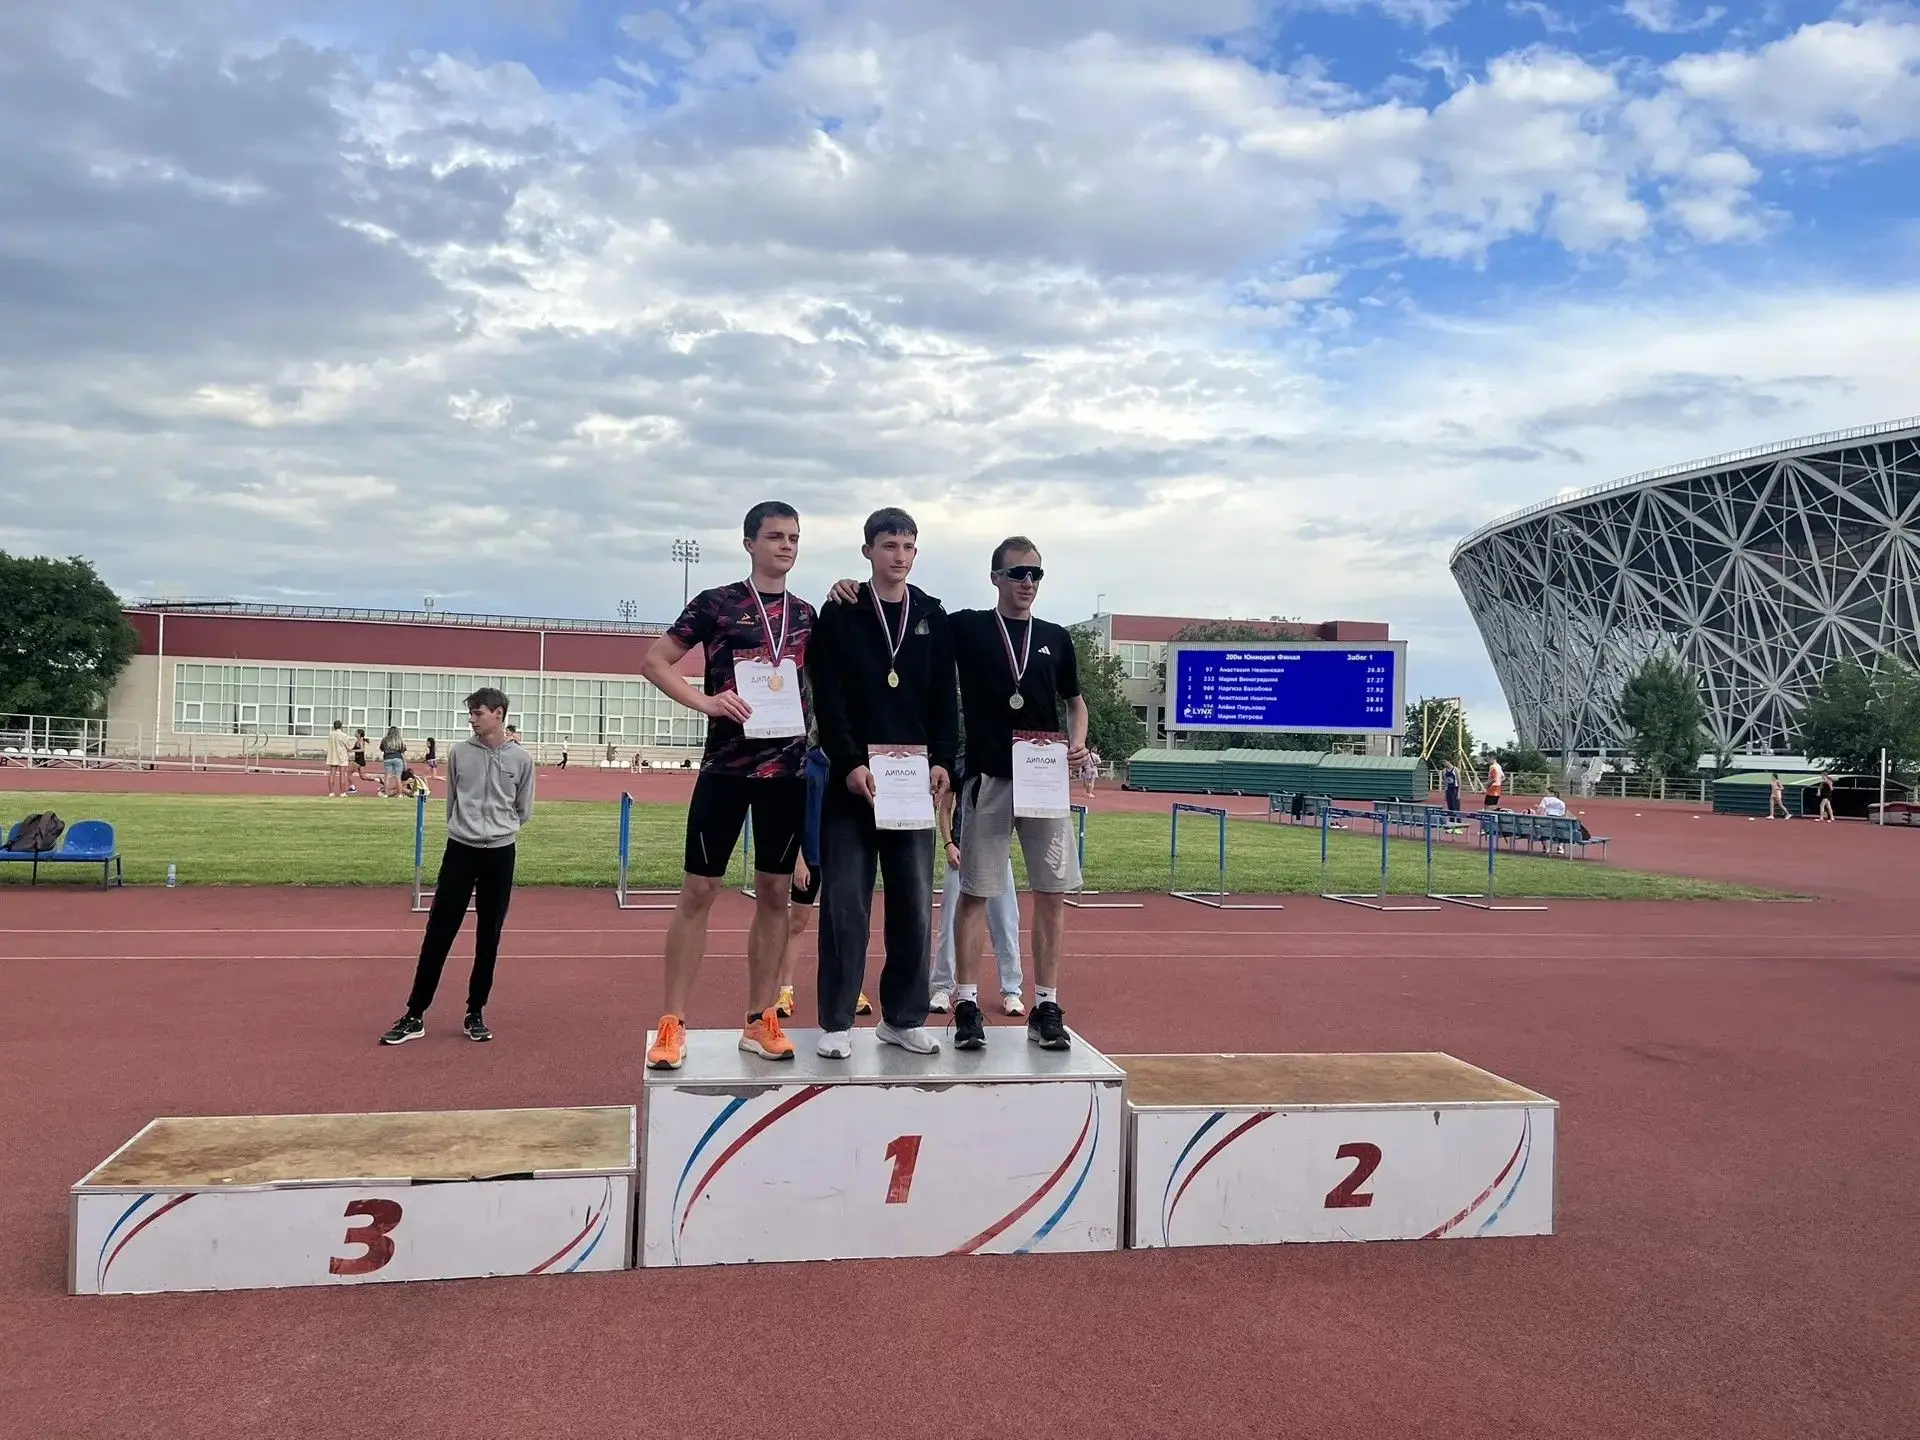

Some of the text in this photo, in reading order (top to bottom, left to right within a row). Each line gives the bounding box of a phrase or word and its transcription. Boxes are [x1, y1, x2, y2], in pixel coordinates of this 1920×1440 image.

[1225, 653, 1301, 662] 200м Юниорки Финал
[1346, 653, 1367, 661] Забег
[1192, 707, 1213, 715] LYNX
[1026, 756, 1057, 764] ДИПЛОМ
[885, 769, 917, 777] ДИПЛОМ
[884, 1135, 923, 1204] 1
[1324, 1142, 1382, 1208] 2
[329, 1199, 403, 1275] 3
